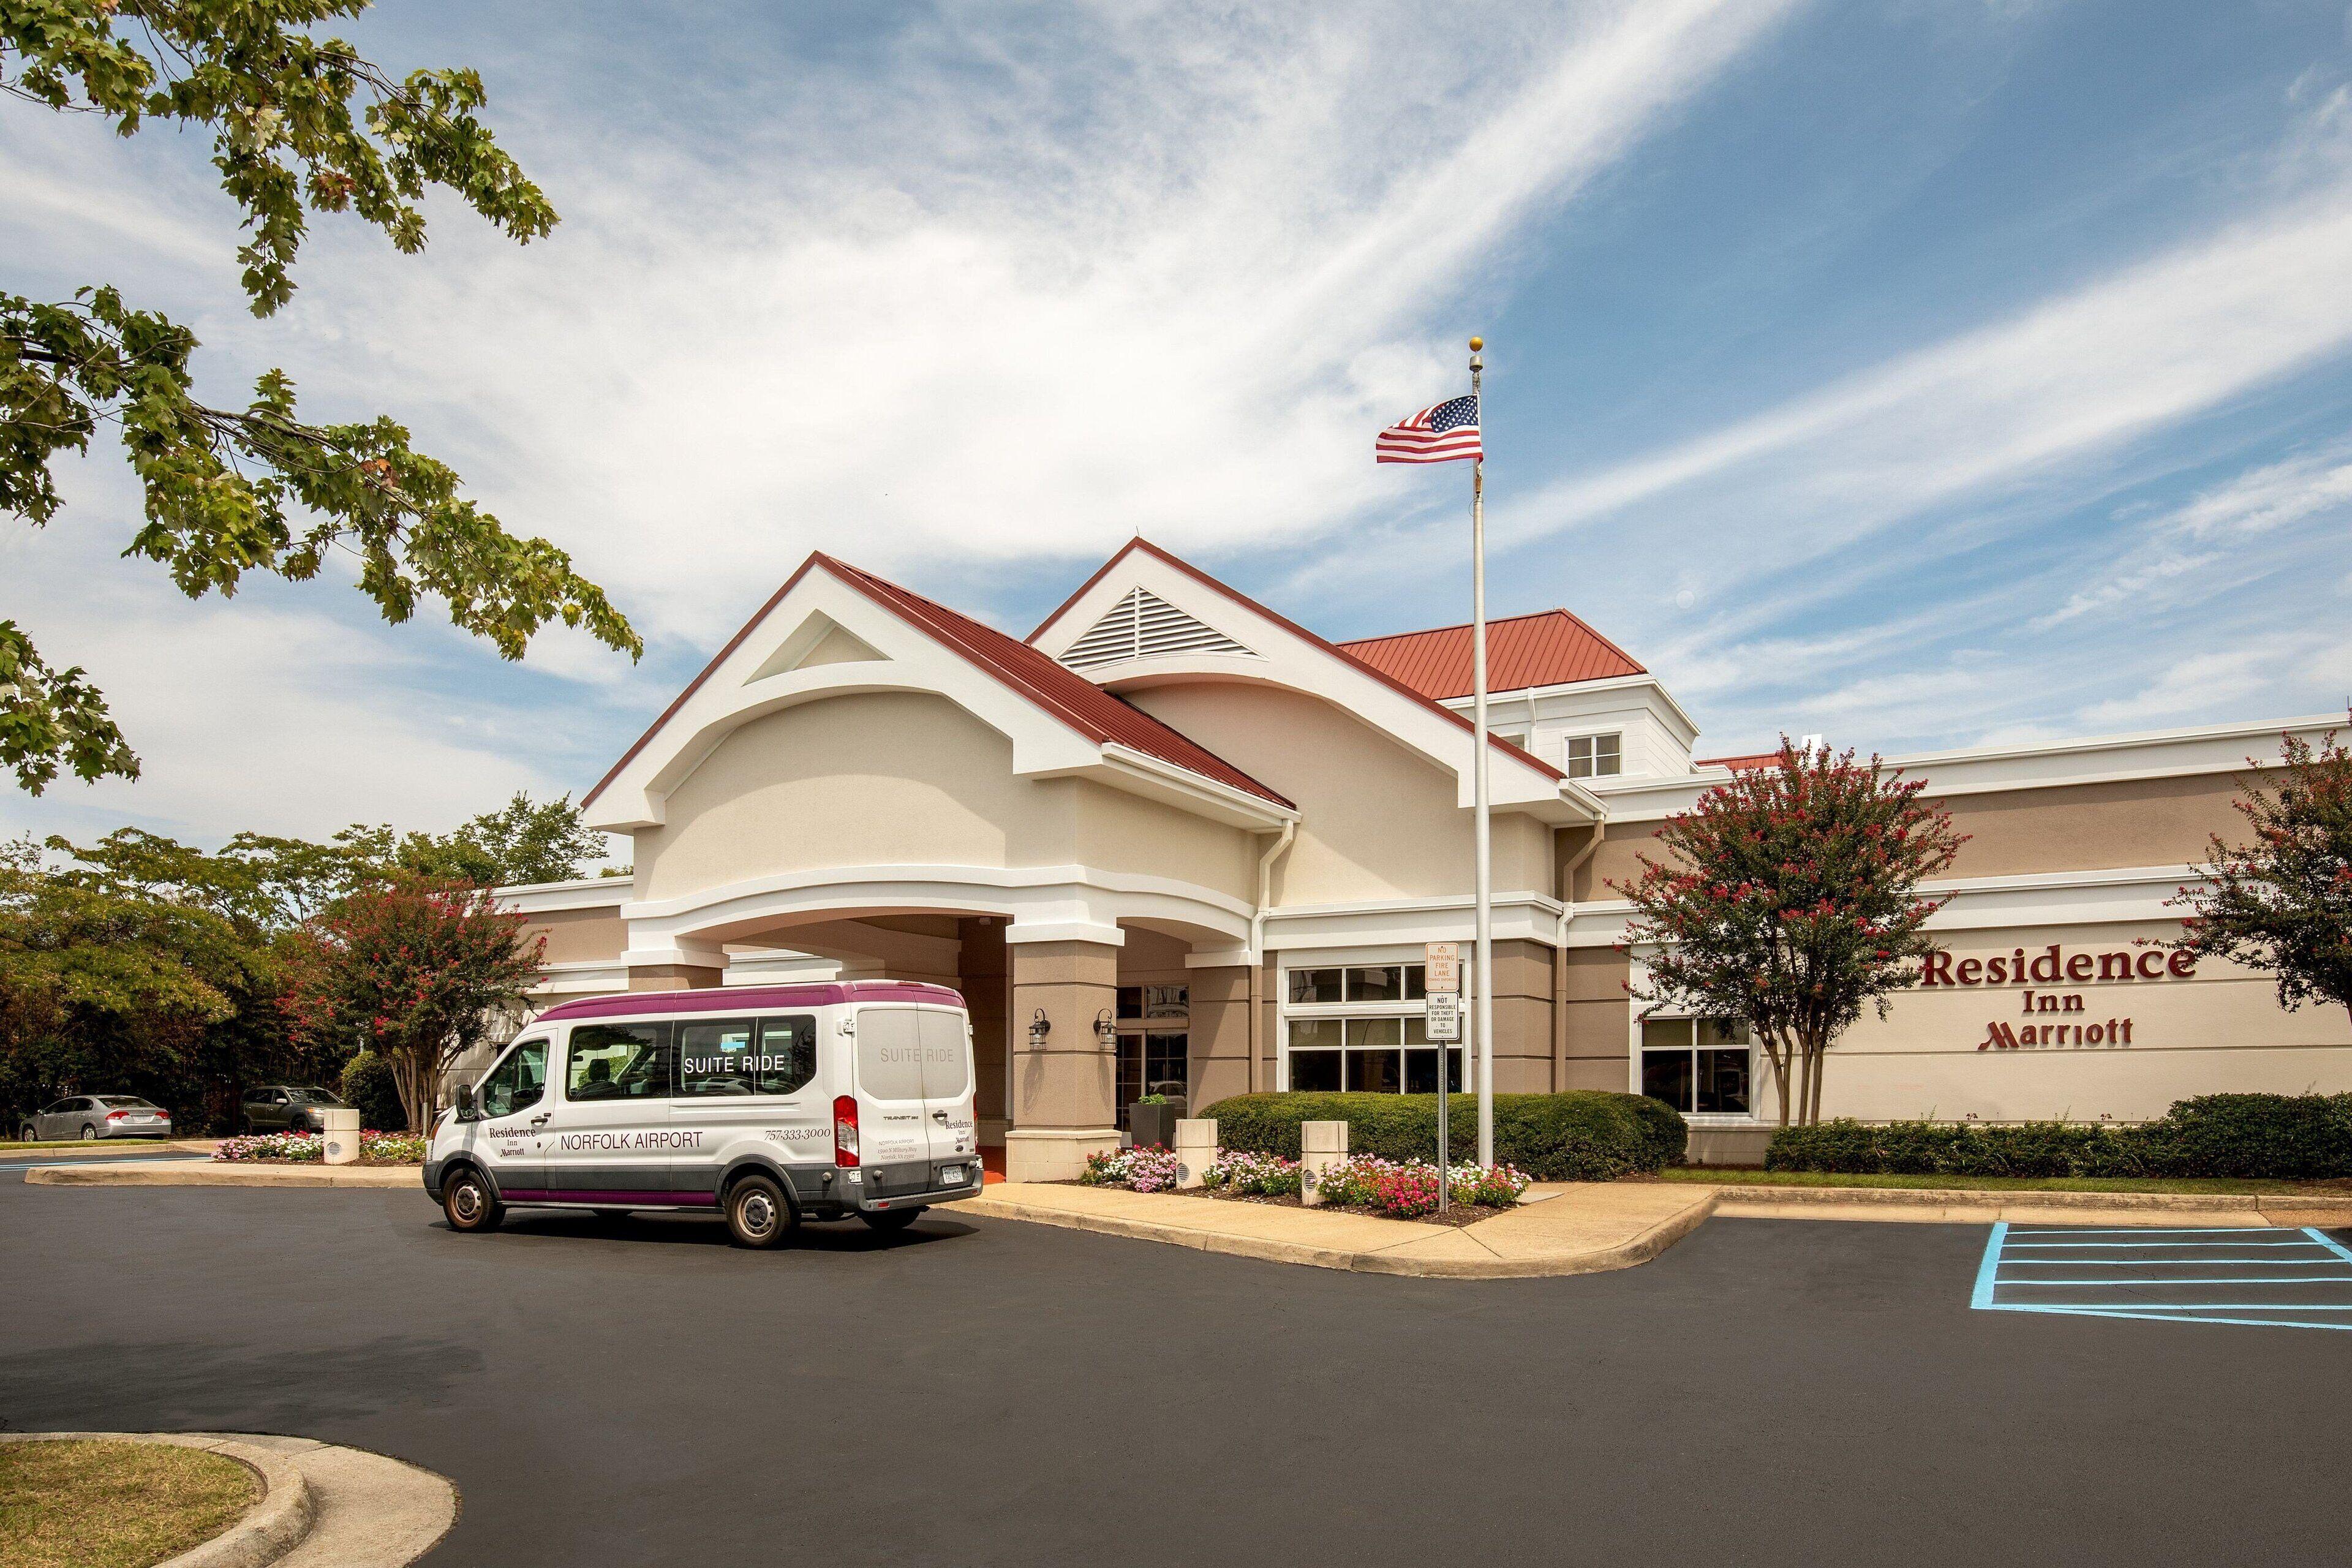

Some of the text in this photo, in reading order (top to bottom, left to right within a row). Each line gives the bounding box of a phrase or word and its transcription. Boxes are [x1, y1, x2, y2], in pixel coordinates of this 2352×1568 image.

[1920, 944, 2196, 986] Residence
[2022, 990, 2085, 1012] Inn
[1977, 1017, 2133, 1050] Marriott
[881, 1048, 954, 1062] SUITE RIDE
[684, 1055, 785, 1074] SUITE RIDE
[489, 1127, 536, 1138] Residence
[945, 1120, 973, 1129] Residence
[561, 1132, 703, 1150] NORFOLK AIRPORT
[500, 1148, 524, 1157] Marriott
